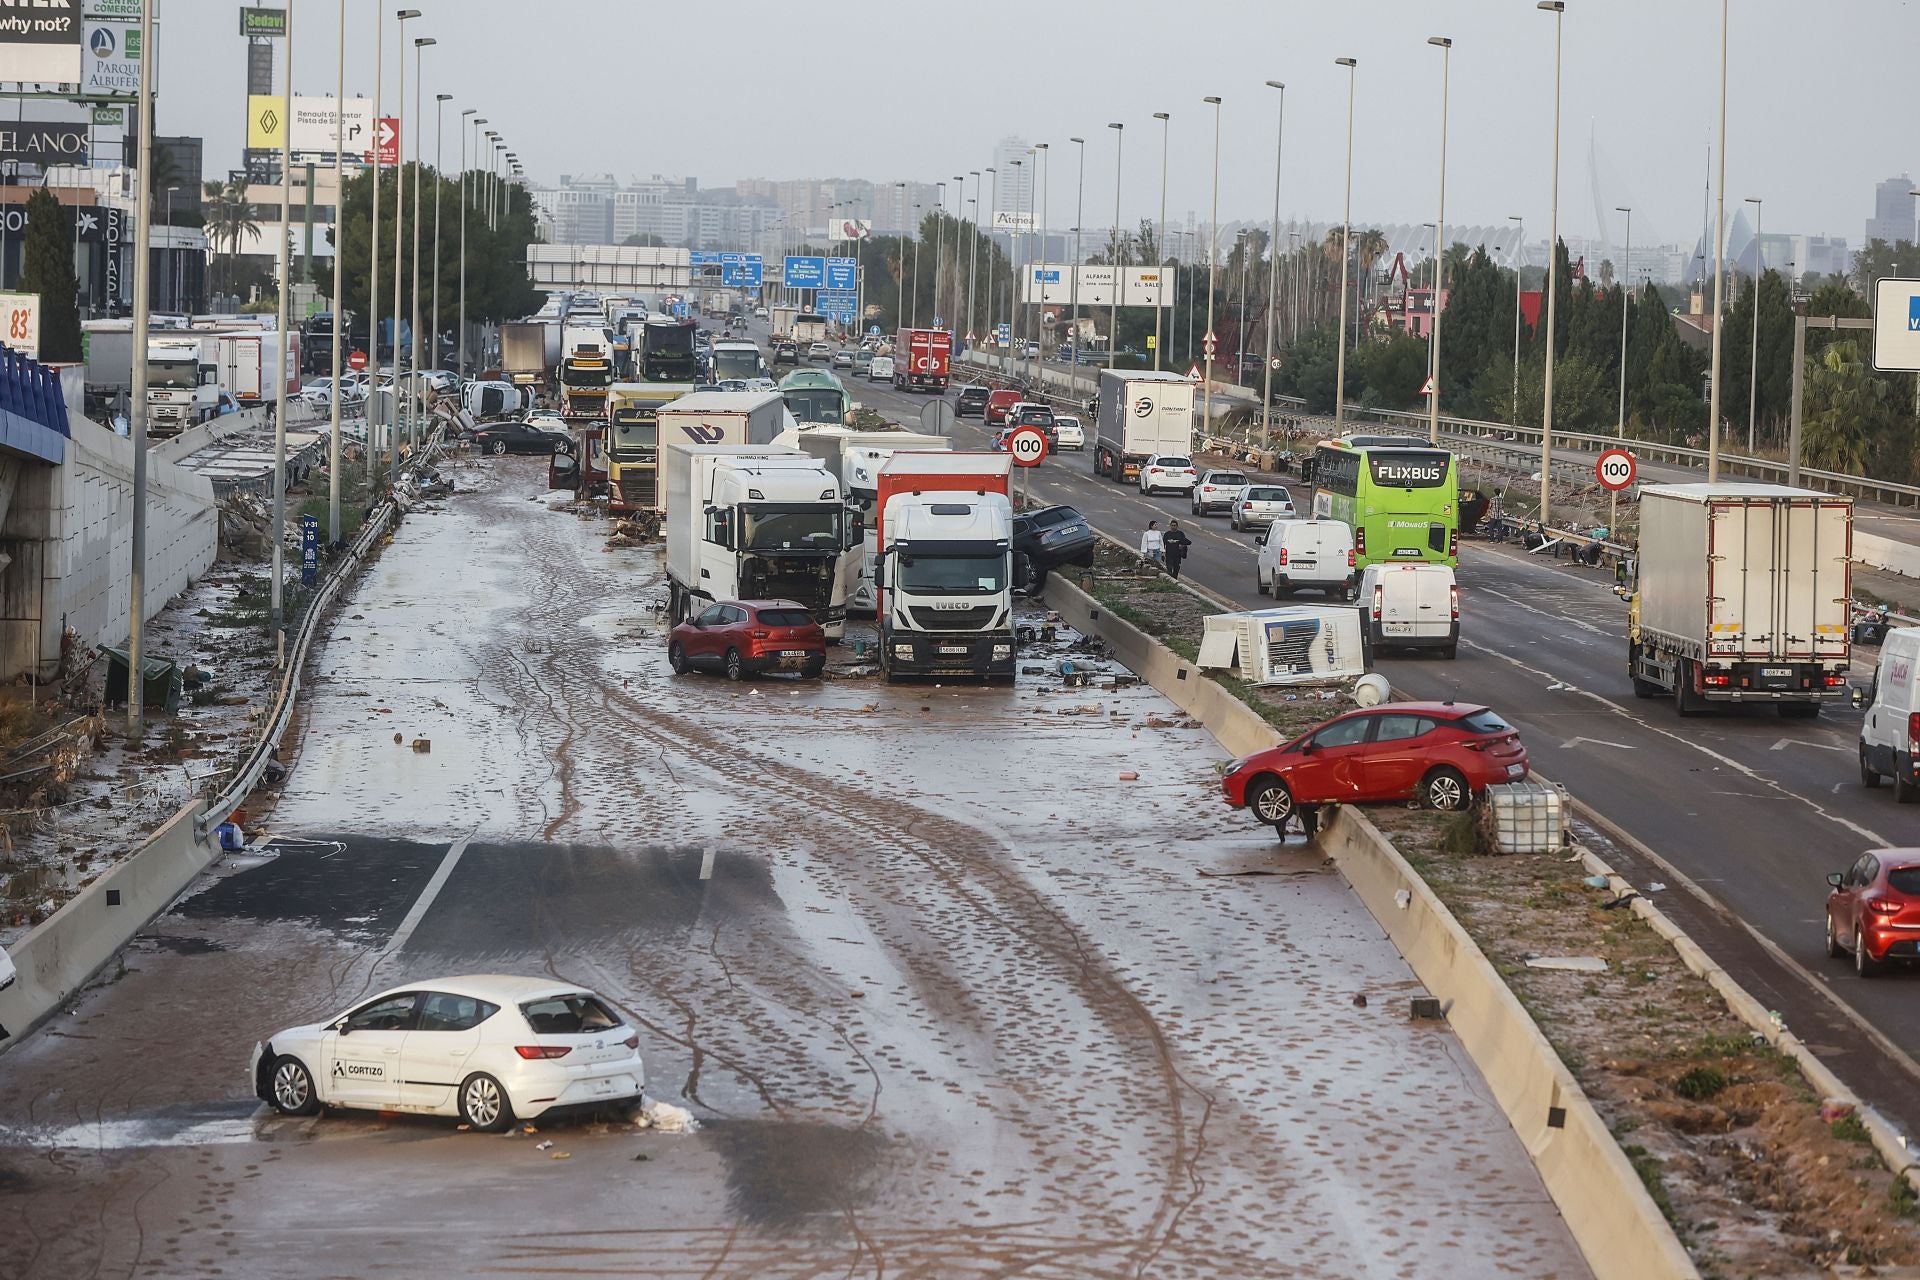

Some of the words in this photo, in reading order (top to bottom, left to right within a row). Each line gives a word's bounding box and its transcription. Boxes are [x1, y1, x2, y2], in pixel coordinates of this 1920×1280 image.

[94, 4, 141, 14] COMERCIA
[0, 15, 31, 34] why
[35, 16, 71, 32] not?
[89, 73, 139, 87] ALBUFER
[328, 111, 362, 119] Giestar
[997, 212, 1035, 225] Atenea
[1015, 439, 1041, 453] 100
[1603, 462, 1629, 477] 100
[935, 602, 970, 610] IVECO
[348, 1065, 383, 1077] CORTIZO
